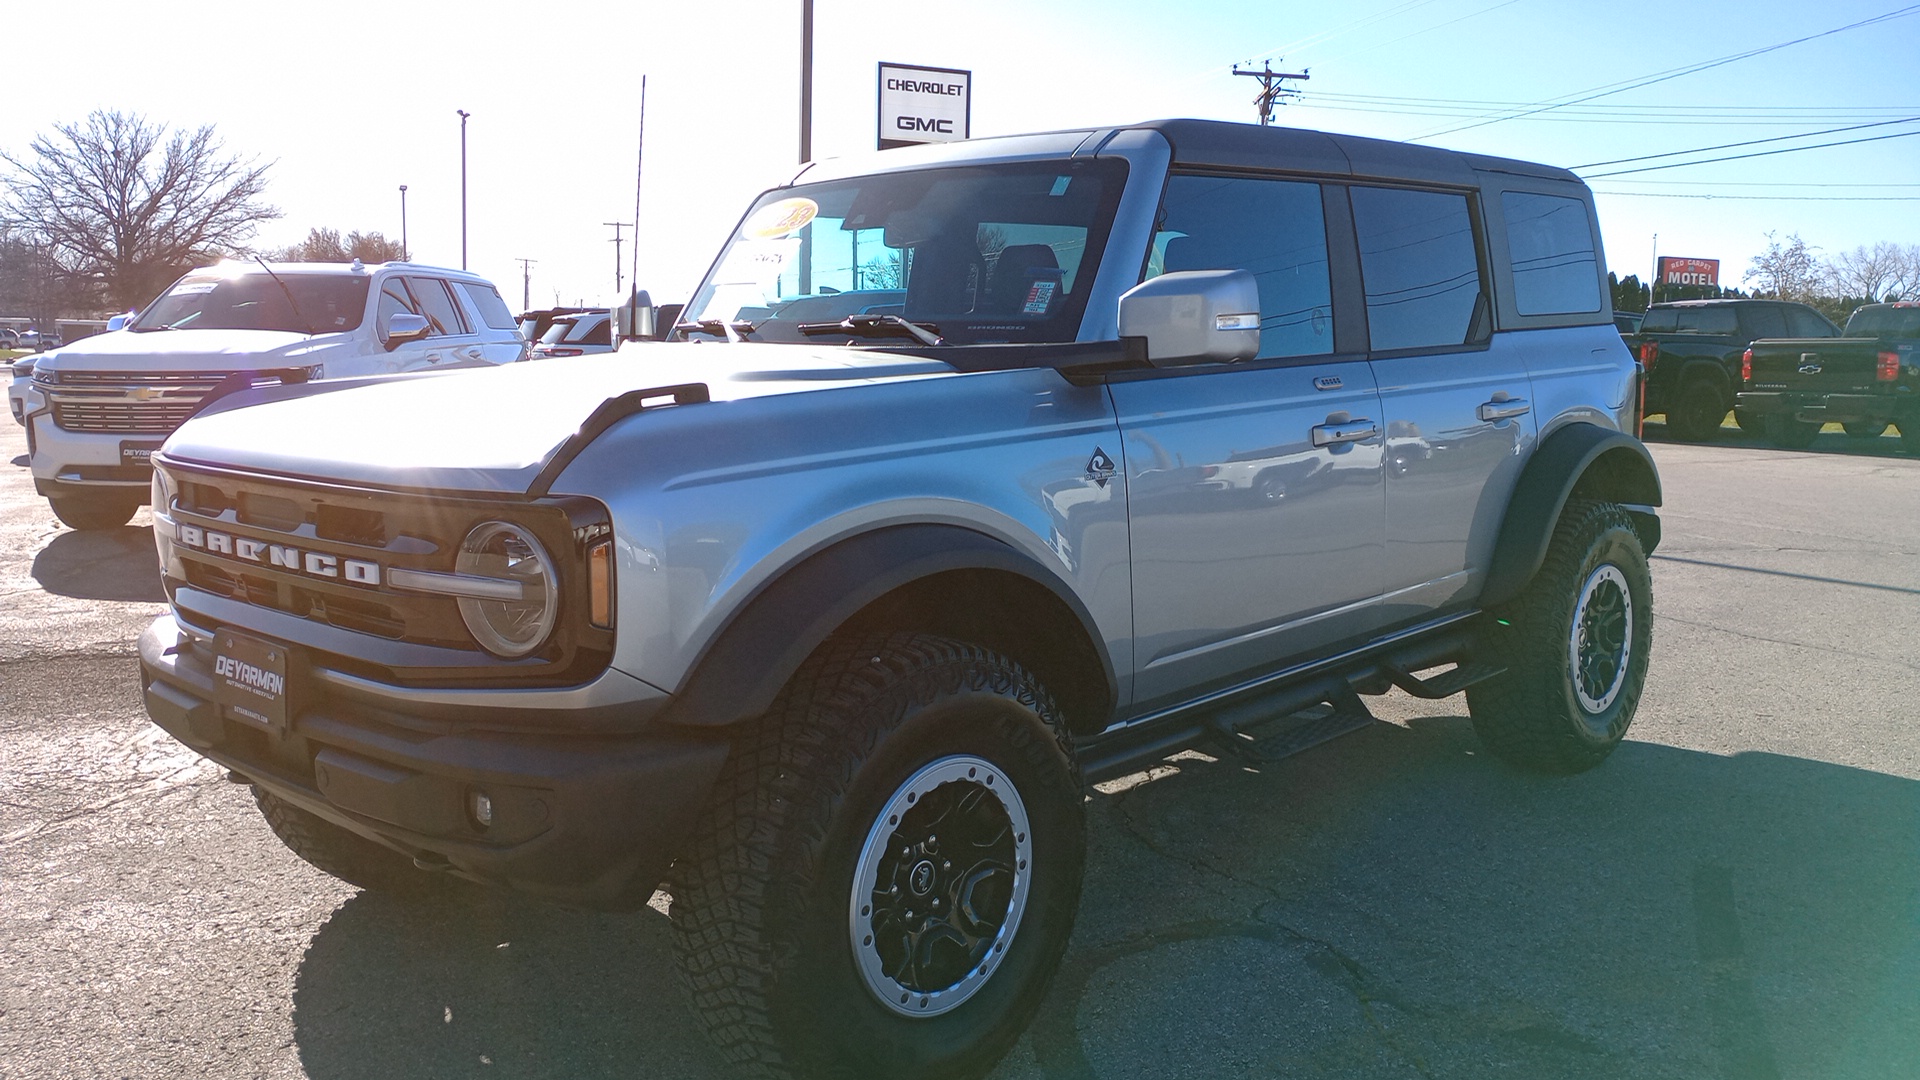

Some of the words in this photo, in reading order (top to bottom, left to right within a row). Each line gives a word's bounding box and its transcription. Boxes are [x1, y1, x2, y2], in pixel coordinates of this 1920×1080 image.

[887, 78, 964, 96] CHEVROLET
[896, 116, 953, 134] GMC
[1670, 260, 1685, 270] RED
[1687, 259, 1712, 271] CARPET
[1668, 271, 1715, 286] MOTEL
[180, 525, 380, 586] BRONCO
[215, 654, 284, 696] DEYARMAN
